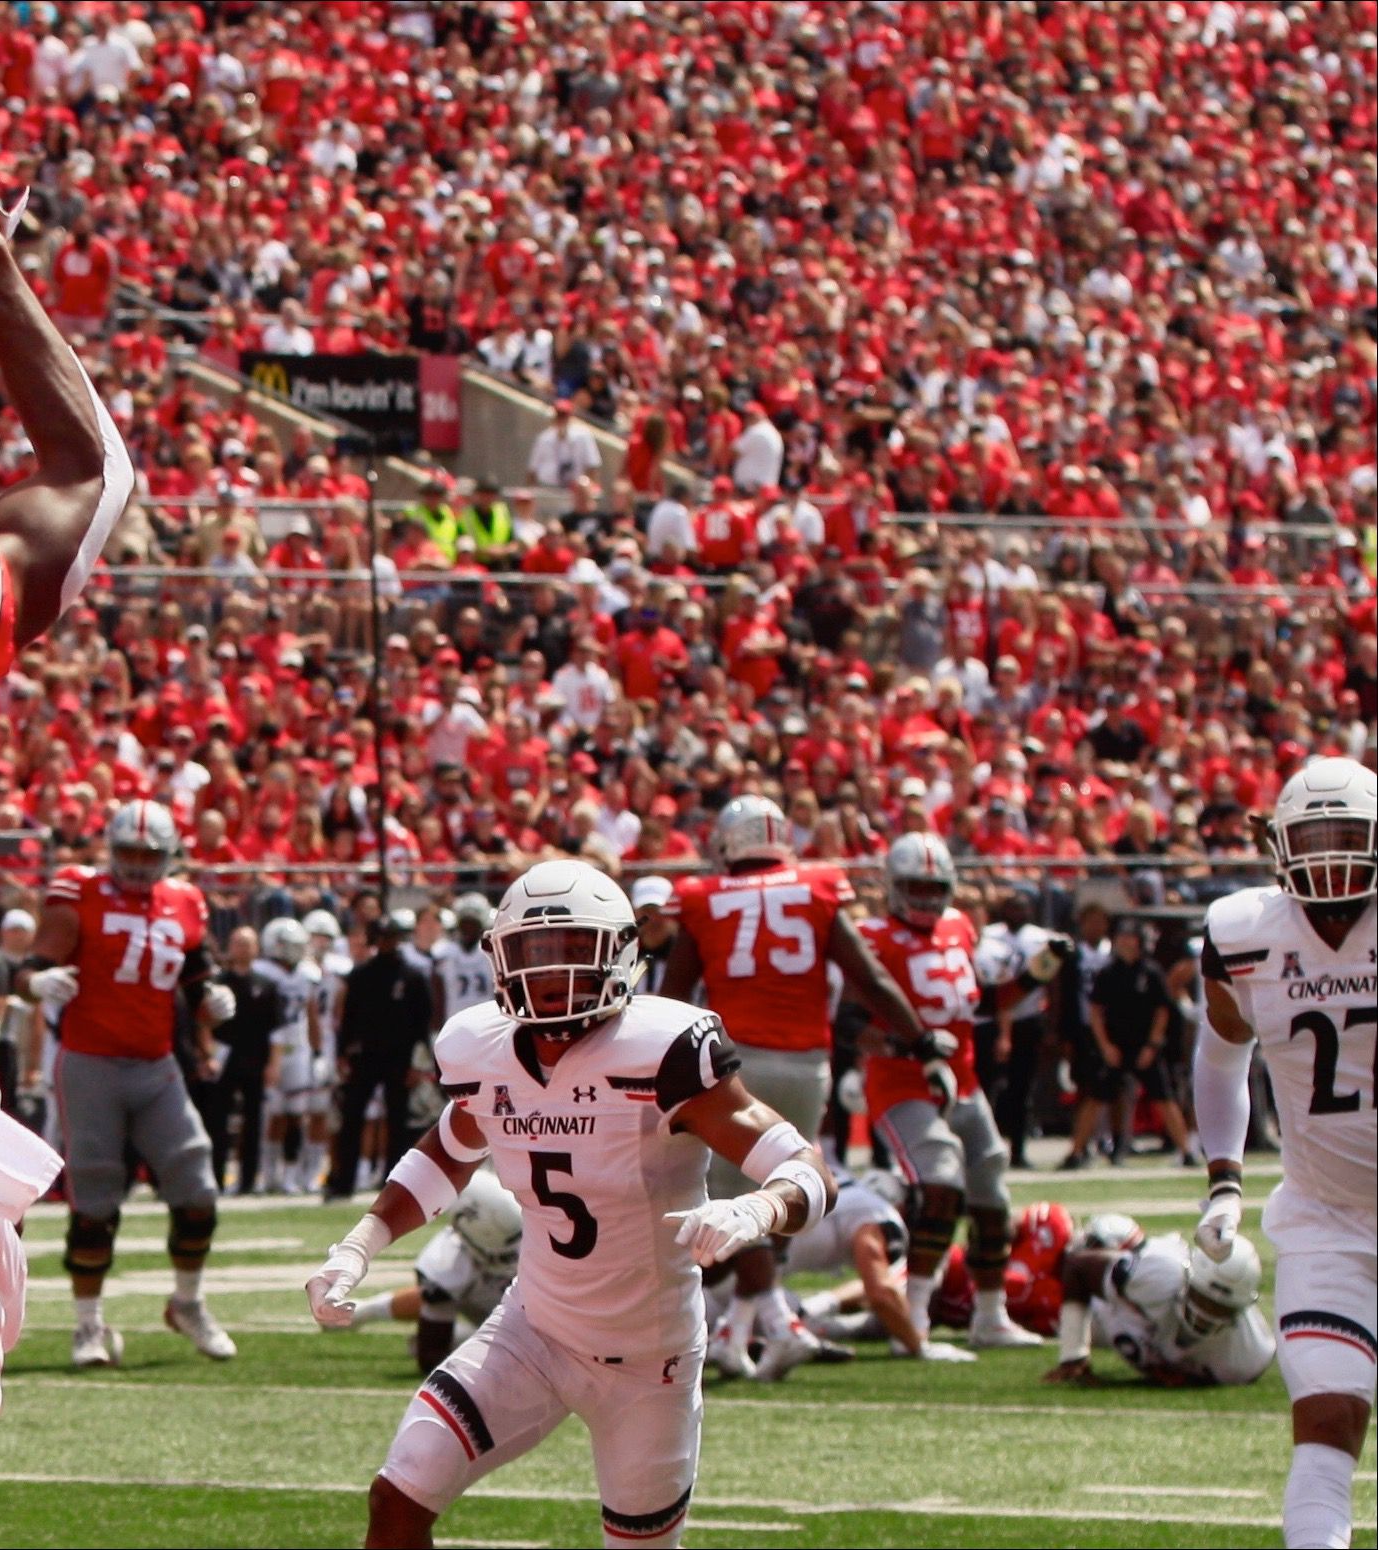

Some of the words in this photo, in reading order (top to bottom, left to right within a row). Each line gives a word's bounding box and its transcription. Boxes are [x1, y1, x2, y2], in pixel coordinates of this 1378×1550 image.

[102, 911, 186, 992] 76
[709, 884, 816, 979] 75
[907, 947, 980, 1026] 52
[502, 1113, 596, 1138] CINCINNATI
[528, 1151, 598, 1261] 5
